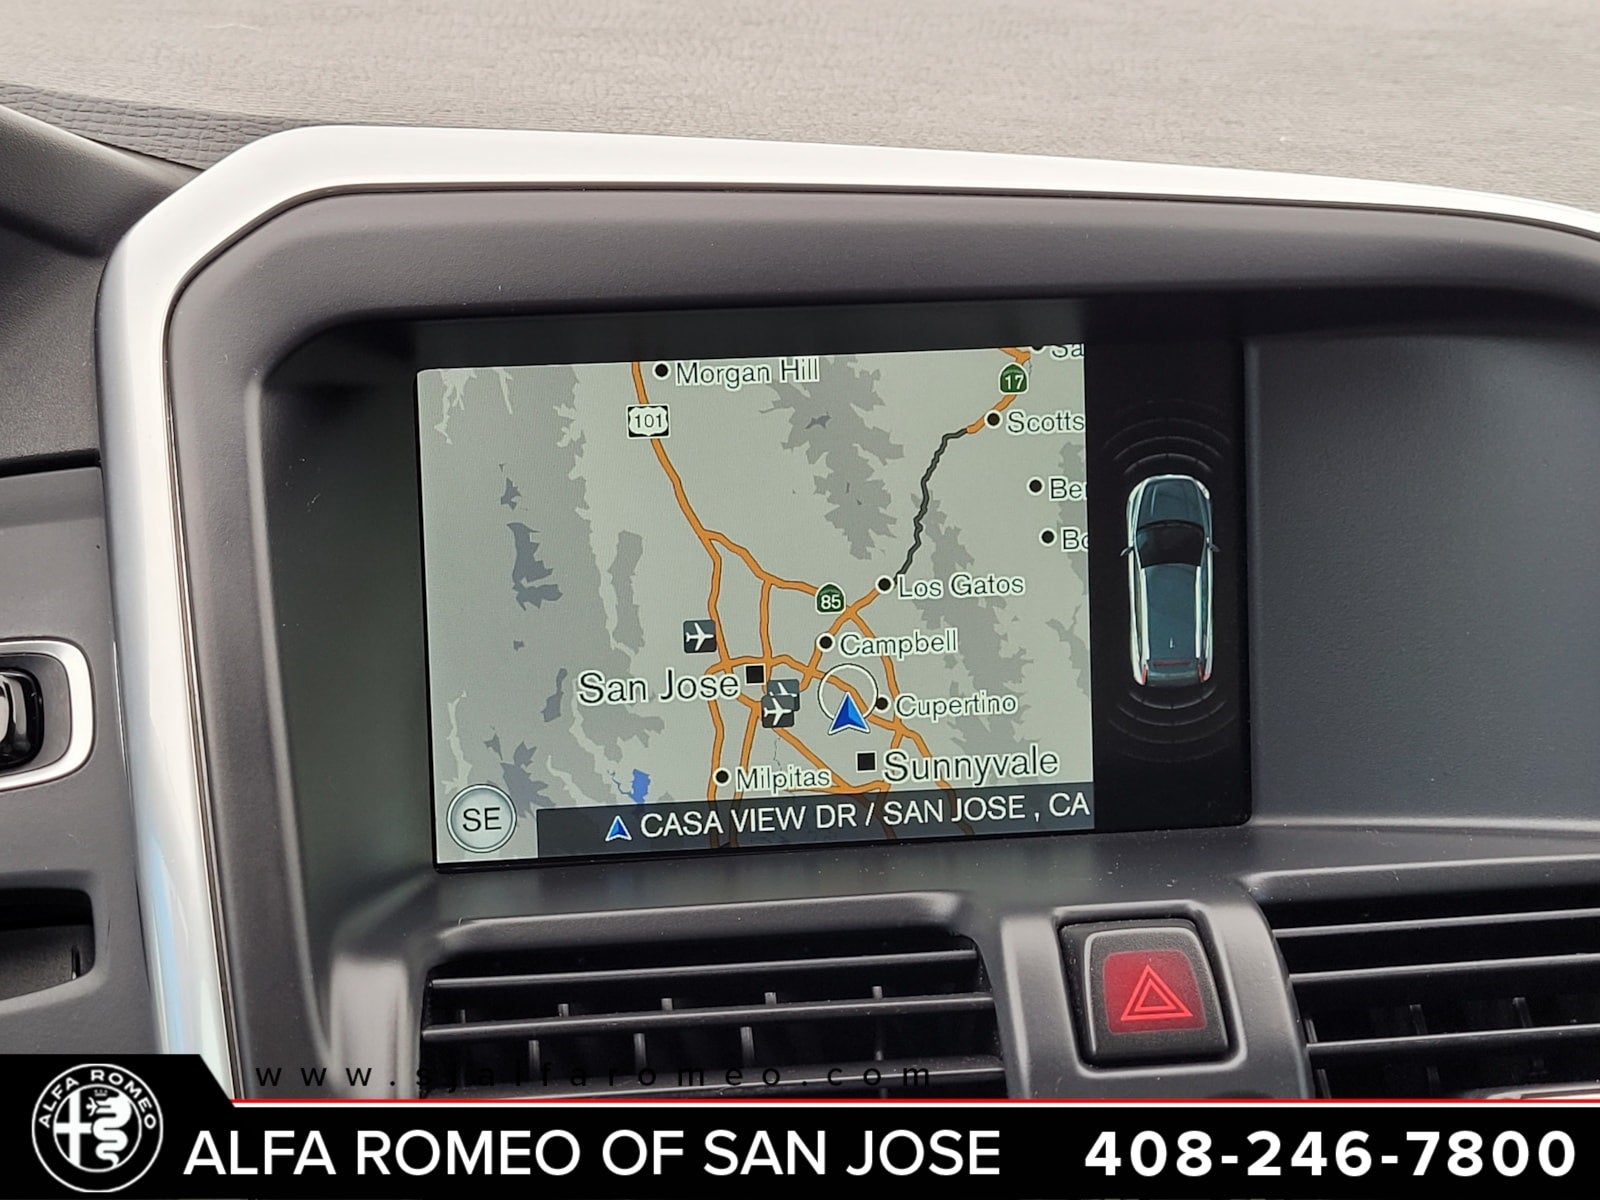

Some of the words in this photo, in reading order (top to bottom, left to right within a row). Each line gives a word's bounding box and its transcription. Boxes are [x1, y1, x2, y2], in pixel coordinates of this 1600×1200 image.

[677, 361, 770, 389] Morgan
[781, 358, 818, 381] Hill
[1004, 373, 1024, 390] 17
[634, 413, 663, 429] 101
[1008, 411, 1085, 433] Scotts
[1050, 478, 1087, 499] Be
[901, 577, 941, 597] Los
[951, 575, 1024, 596] Gatos
[821, 593, 842, 609] 85
[840, 629, 958, 657] Campbell
[578, 672, 646, 704] San
[660, 669, 739, 700] Jose
[896, 690, 1017, 720] Cupertino
[884, 745, 1058, 784] Sunnyvale
[737, 766, 830, 793] Milpitas
[462, 807, 502, 832] SE
[641, 811, 723, 837] CASA
[731, 806, 806, 834] VIEW
[816, 804, 857, 829] DR
[883, 799, 943, 825] SAN
[951, 795, 1026, 823] JOSE
[1049, 792, 1091, 817] CA
